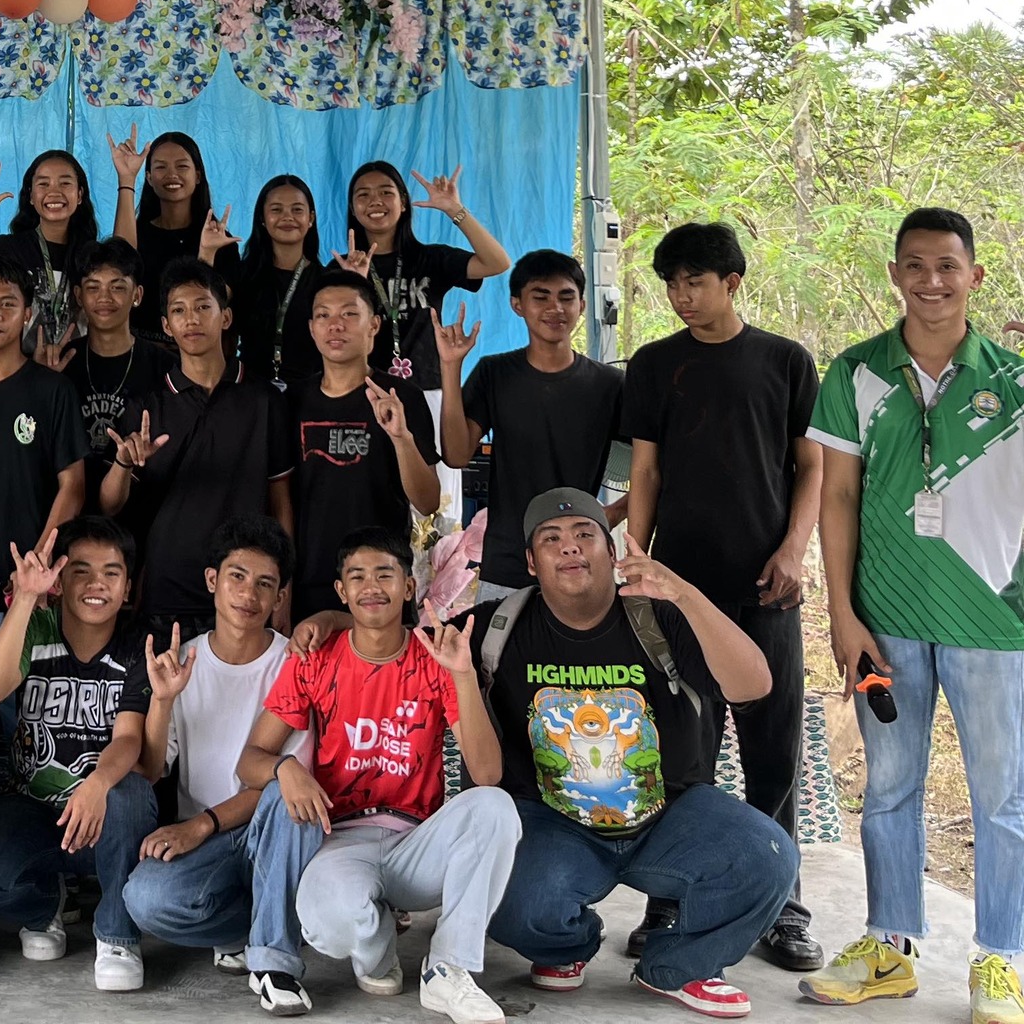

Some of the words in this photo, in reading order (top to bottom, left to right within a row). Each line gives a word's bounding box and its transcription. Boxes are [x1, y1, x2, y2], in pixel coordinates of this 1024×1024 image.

[937, 375, 951, 395] NOTRE
[527, 663, 646, 685] HGHMNDS
[380, 717, 407, 738] SAN
[375, 734, 411, 757] JOSE
